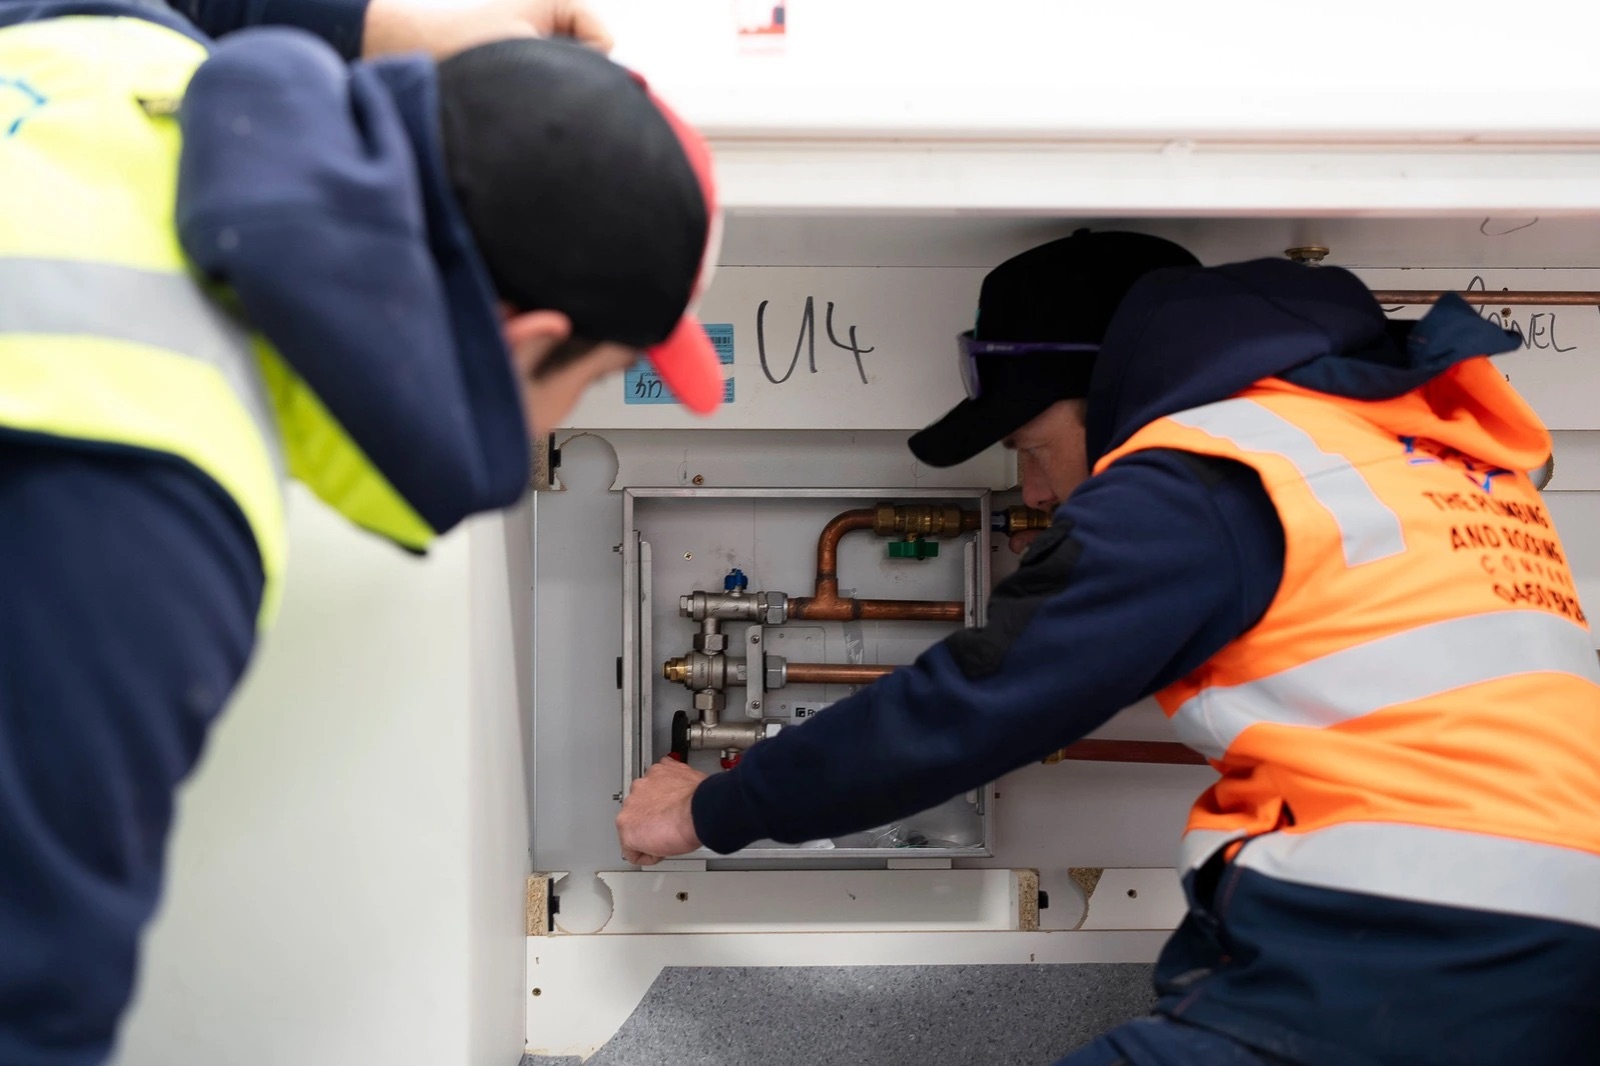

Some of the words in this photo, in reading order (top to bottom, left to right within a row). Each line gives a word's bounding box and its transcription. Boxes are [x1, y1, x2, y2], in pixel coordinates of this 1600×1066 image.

[757, 296, 875, 384] U4
[1421, 490, 1476, 513] THE
[1450, 525, 1500, 552] AND
